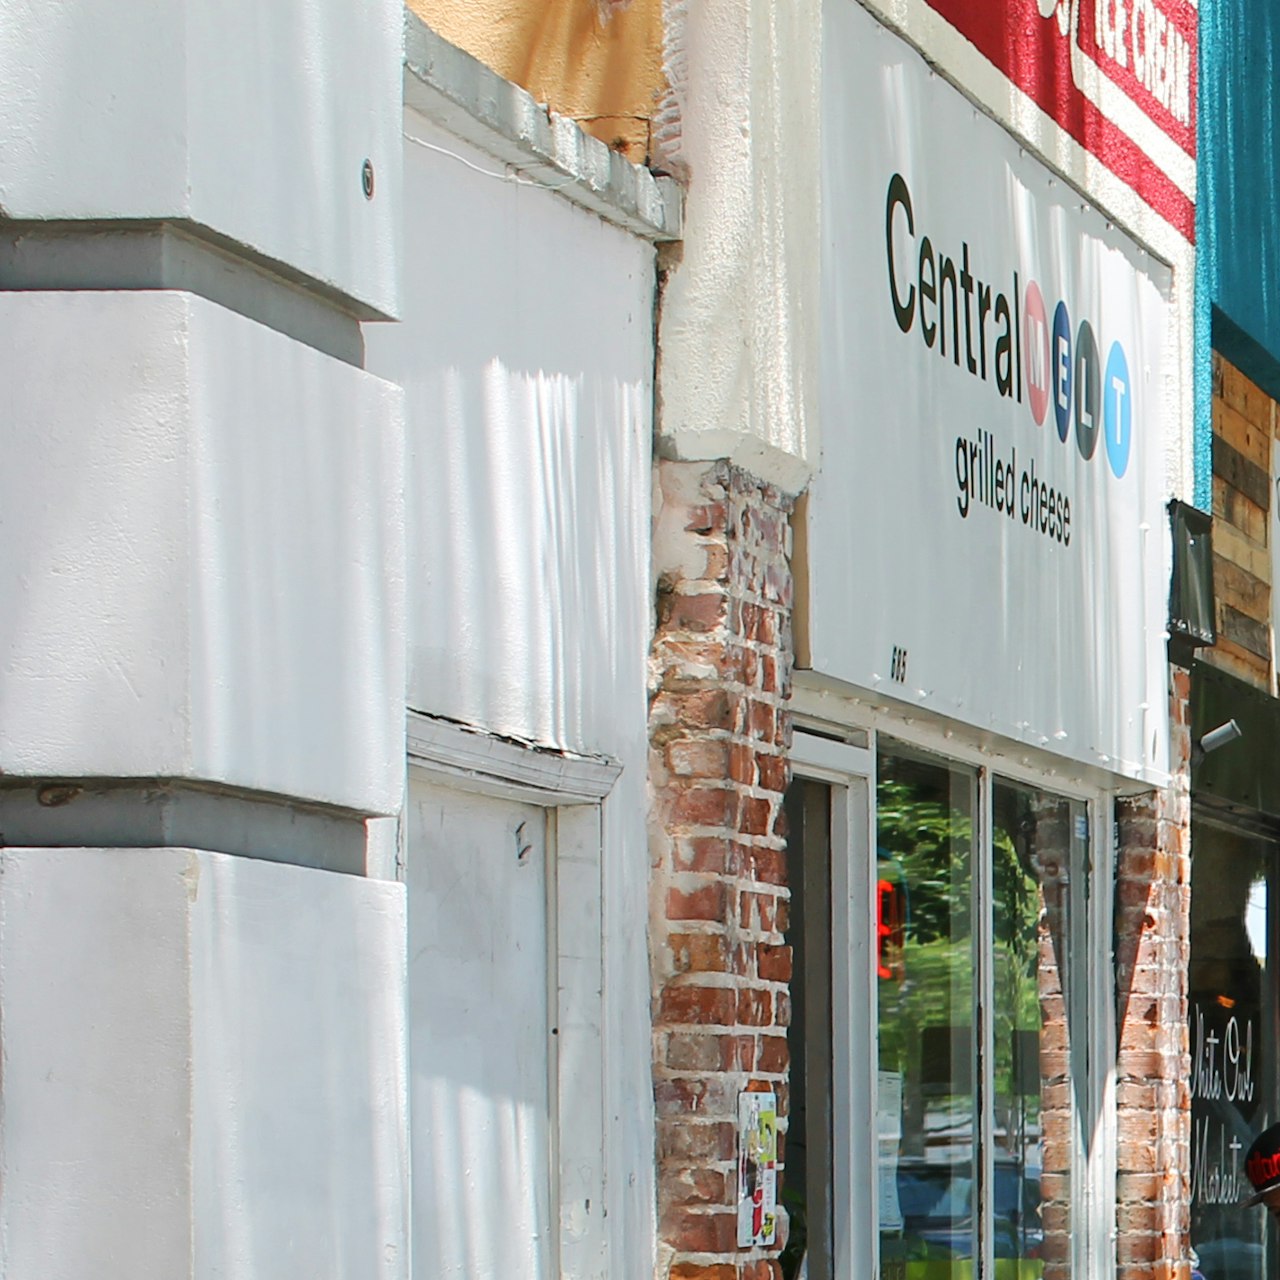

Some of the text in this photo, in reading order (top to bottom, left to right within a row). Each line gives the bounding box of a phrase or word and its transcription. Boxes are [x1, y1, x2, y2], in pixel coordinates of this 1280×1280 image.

[886, 173, 1126, 445] Central MELT
[956, 428, 1071, 547] grilled cheese
[1224, 1016, 1254, 1102] Owl
[1189, 1115, 1242, 1205] Market
